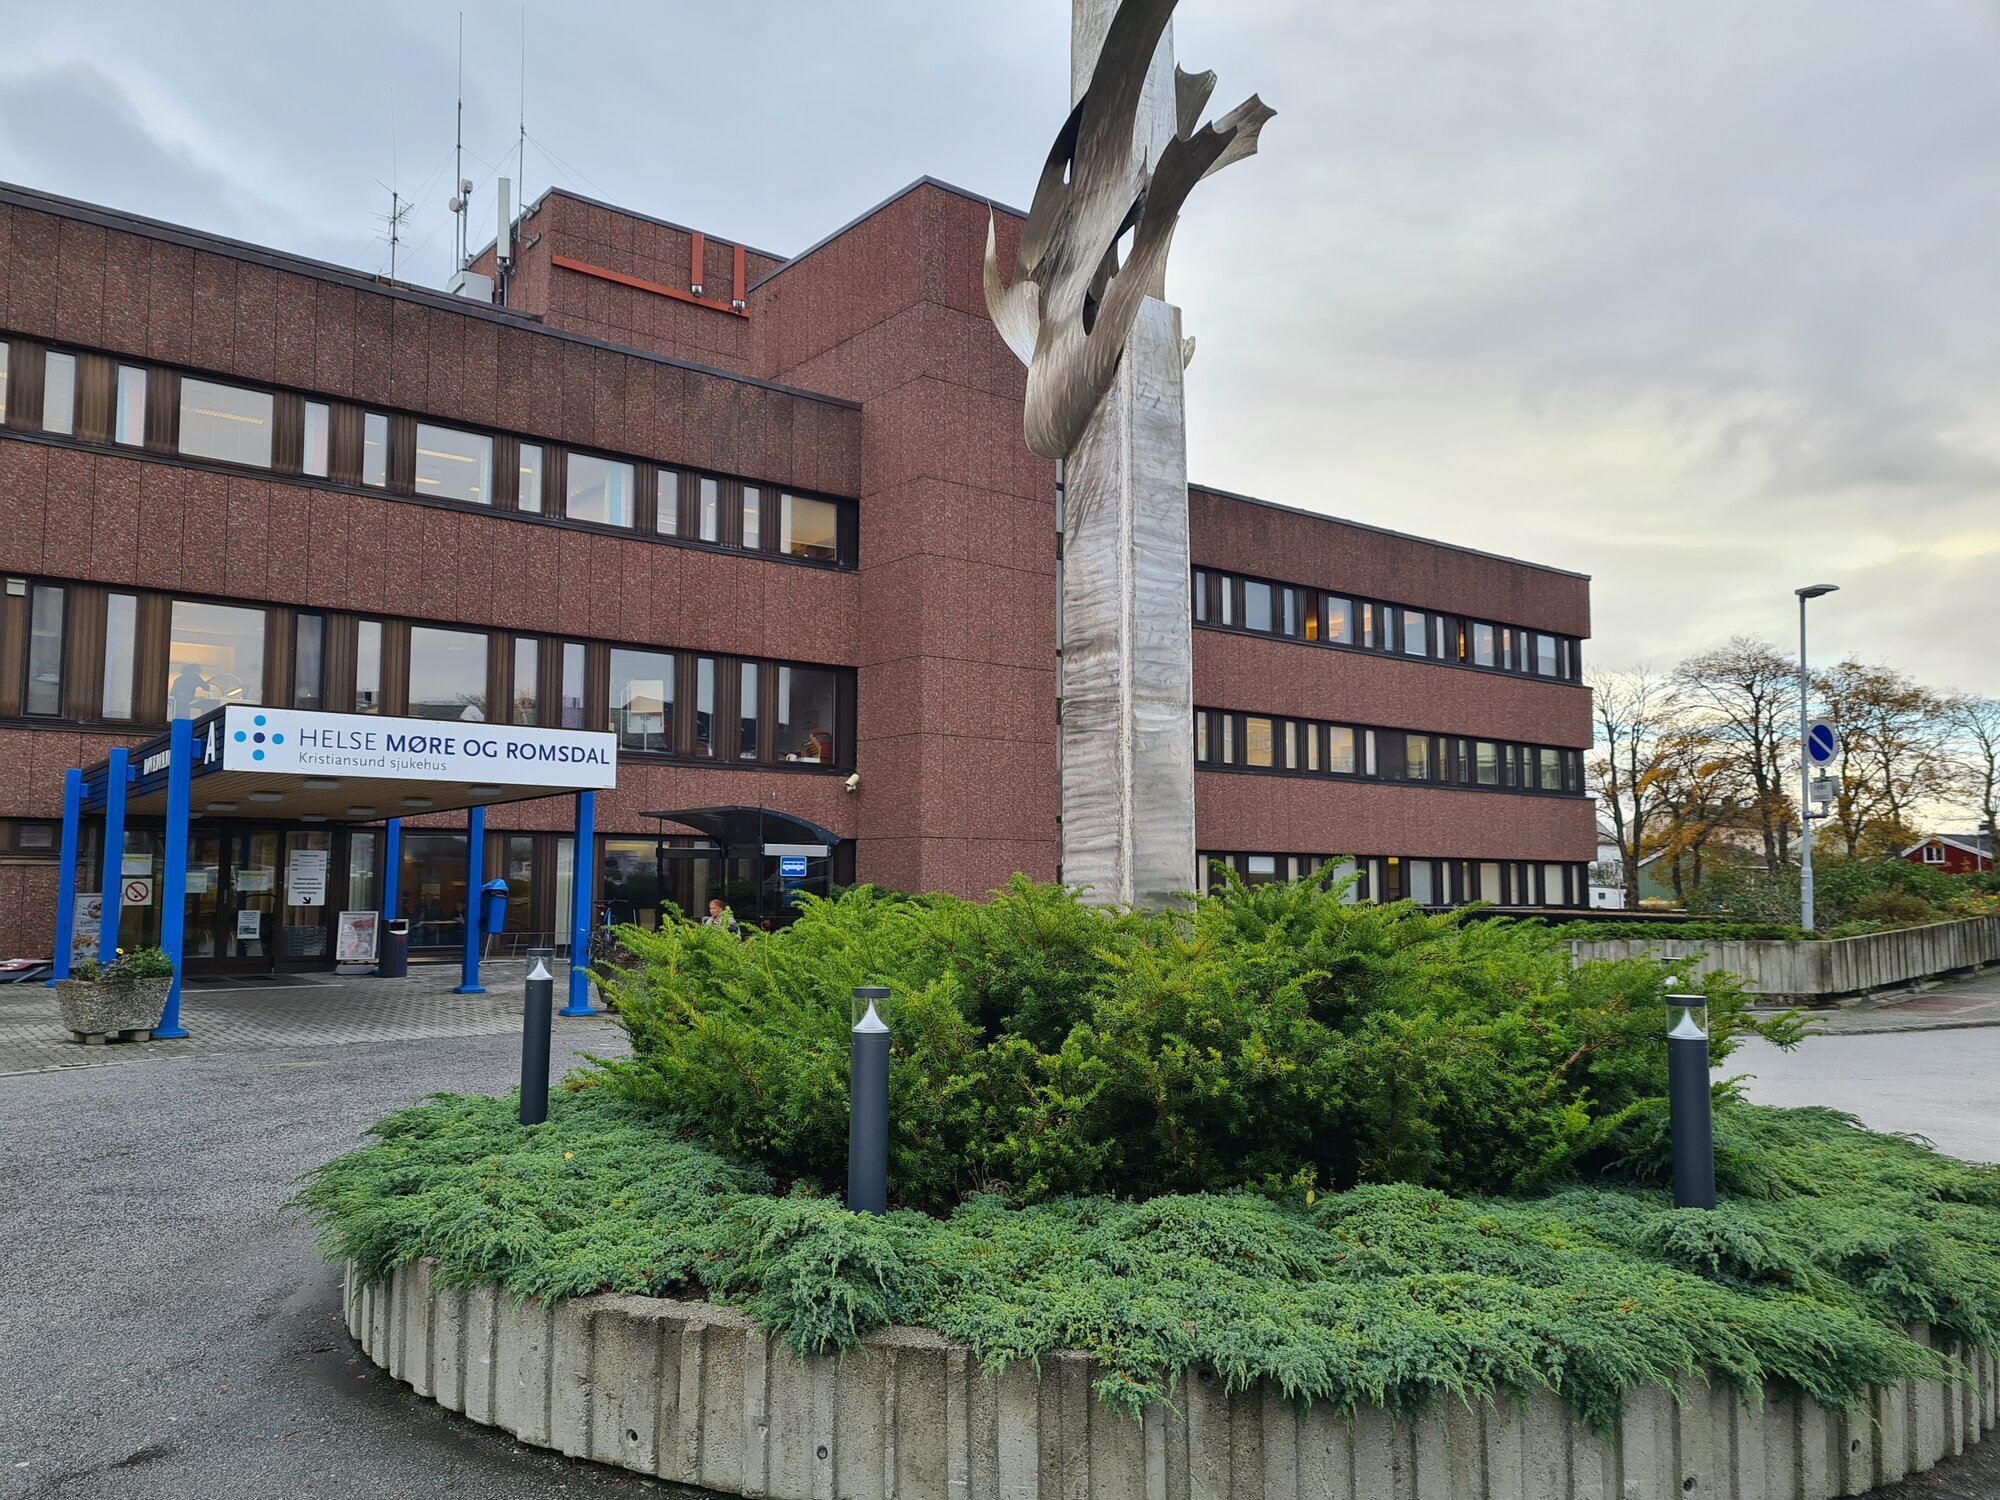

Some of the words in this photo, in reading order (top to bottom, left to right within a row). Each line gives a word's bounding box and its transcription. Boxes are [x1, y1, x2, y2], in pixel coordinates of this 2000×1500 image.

[204, 720, 216, 765] A
[299, 728, 377, 751] HELSE
[386, 734, 456, 756] MØRE
[463, 739, 498, 758] OG
[506, 742, 610, 765] ROMSDAL
[299, 751, 385, 768] Kristiansund
[390, 757, 447, 772] sjukehus
